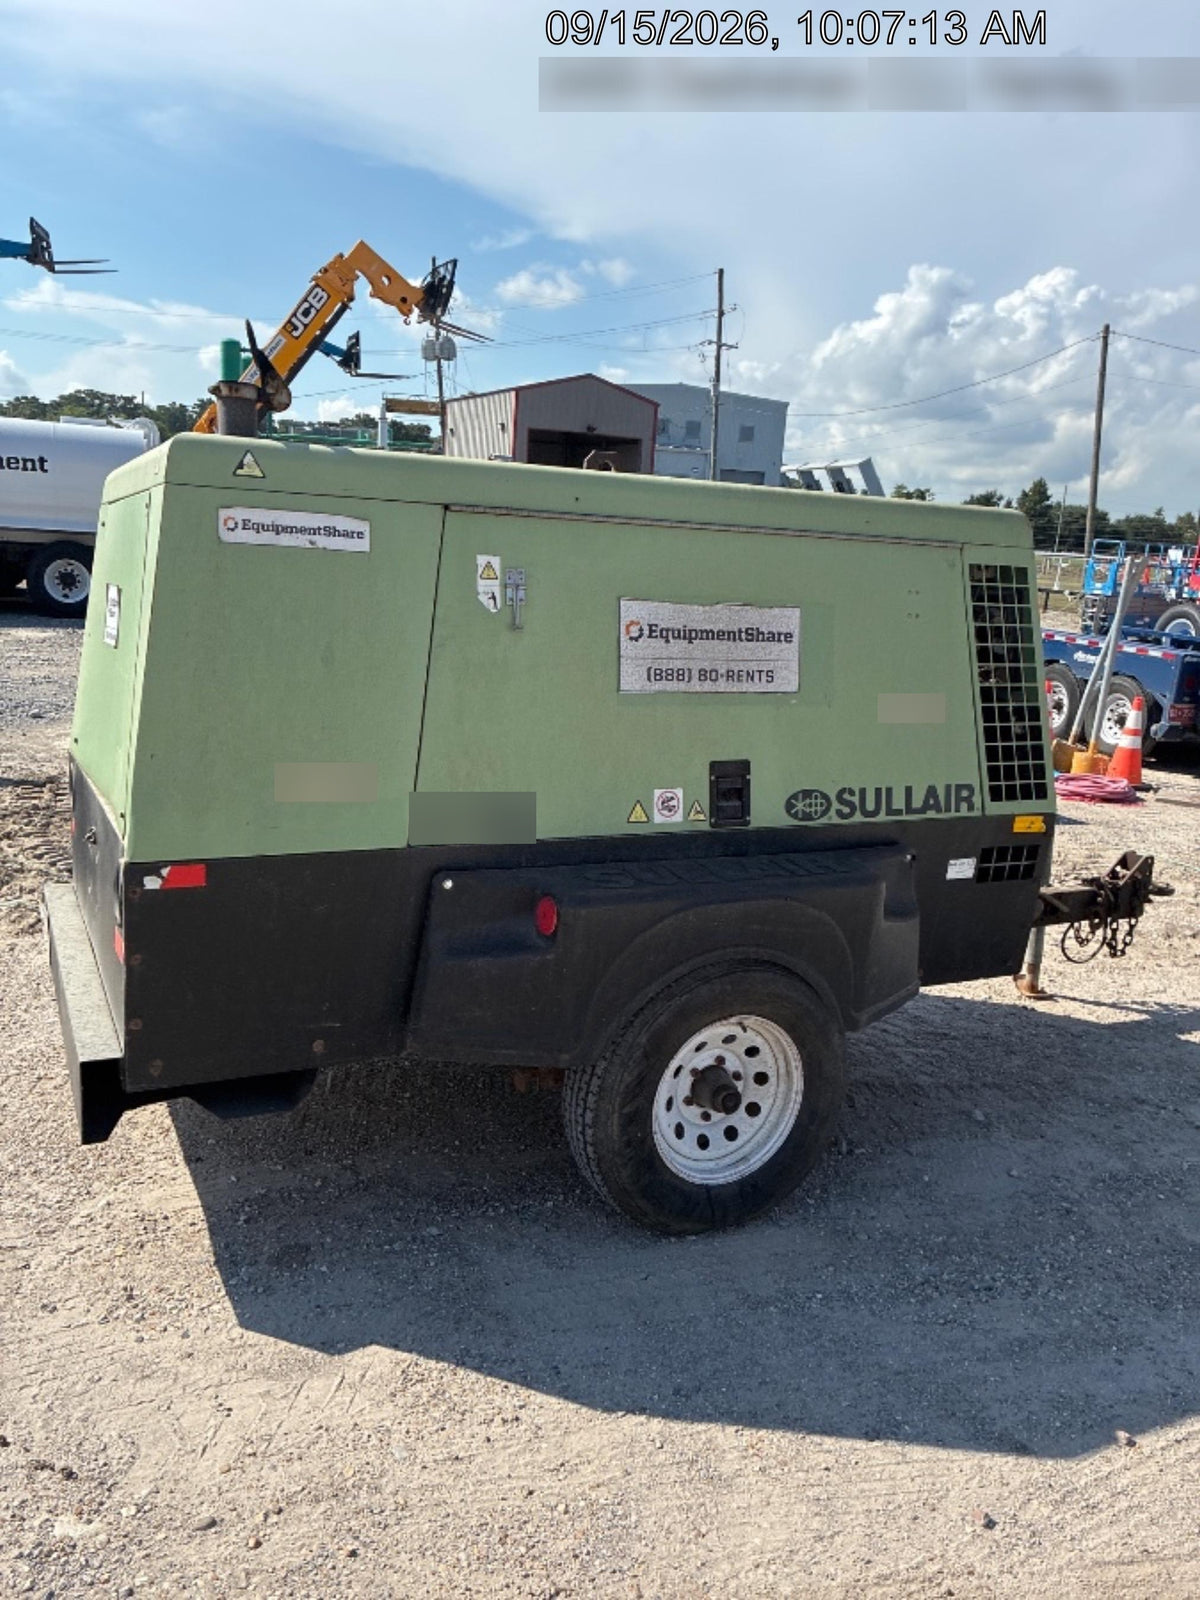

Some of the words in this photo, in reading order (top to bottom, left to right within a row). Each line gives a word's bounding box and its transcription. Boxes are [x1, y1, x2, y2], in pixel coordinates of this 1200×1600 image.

[291, 286, 329, 337] JCB
[0, 456, 48, 473] ent
[241, 518, 365, 540] EquipmentShare
[646, 623, 794, 644] EquipmentShare
[835, 783, 976, 820] SULLAIR
